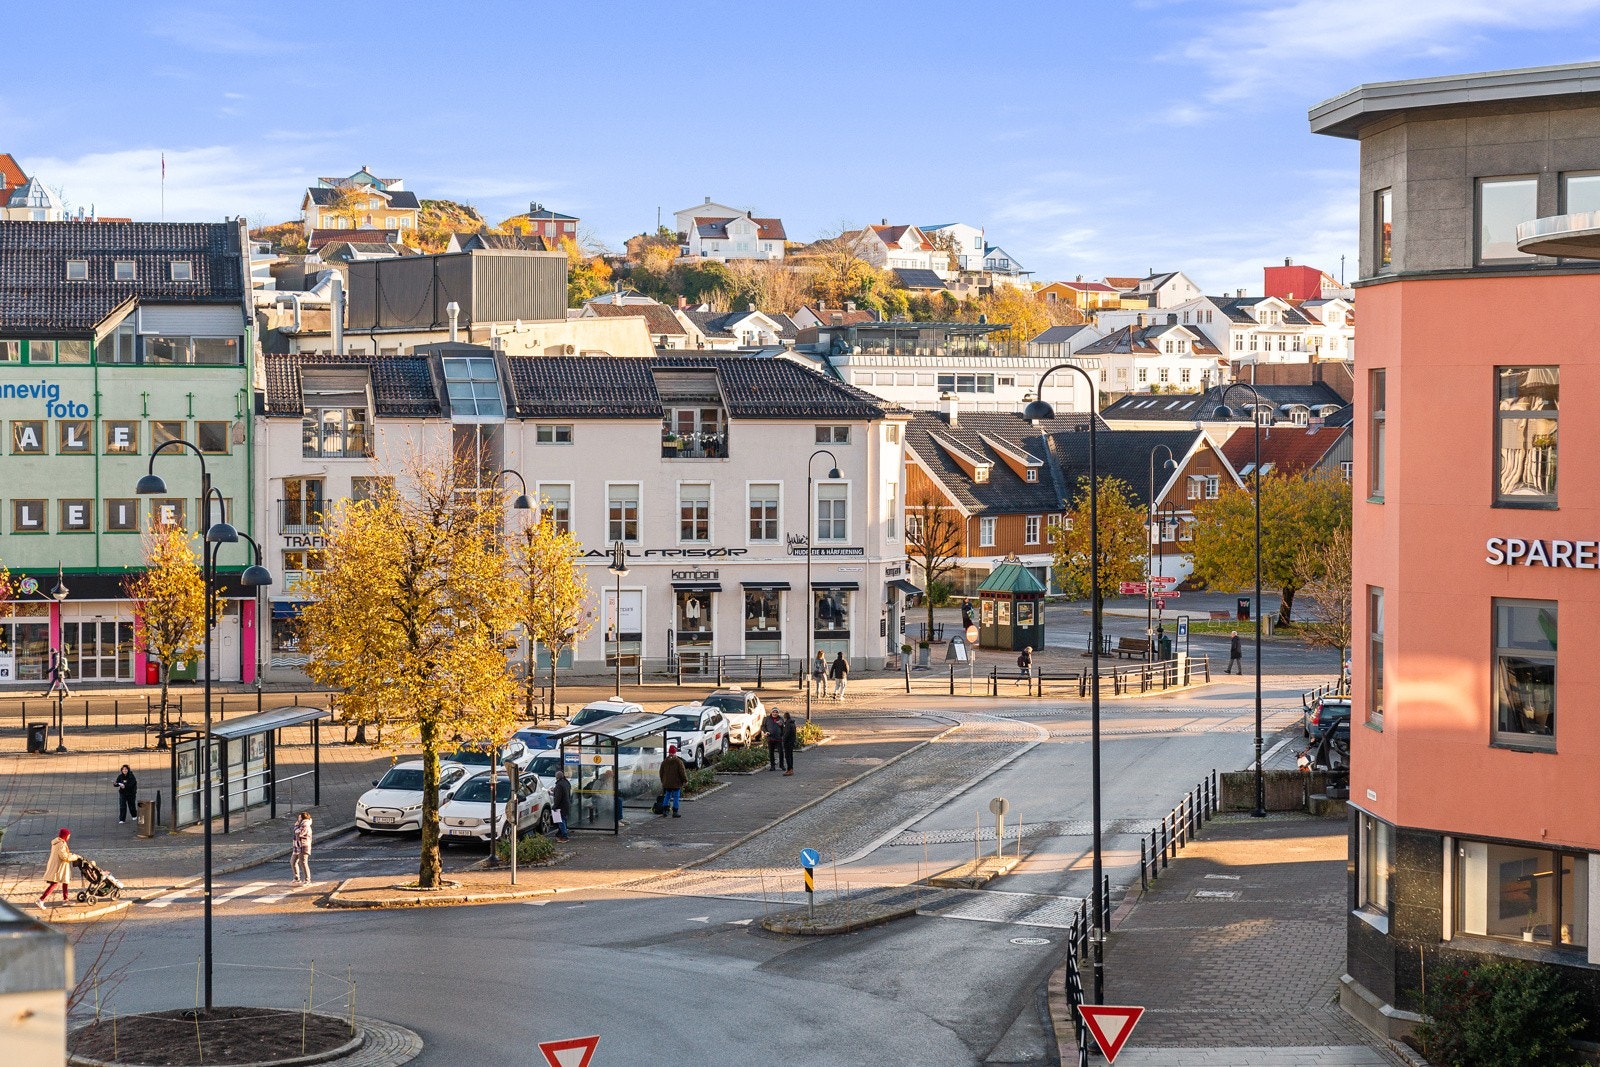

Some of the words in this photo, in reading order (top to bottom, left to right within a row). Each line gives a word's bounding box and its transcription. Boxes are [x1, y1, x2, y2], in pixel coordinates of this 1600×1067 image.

[0, 380, 59, 403] nevig
[46, 400, 89, 418] foto
[21, 427, 129, 447] ALE
[22, 505, 176, 525] LEIE
[645, 547, 748, 557] FRISØR
[1485, 537, 1600, 569] SPARE
